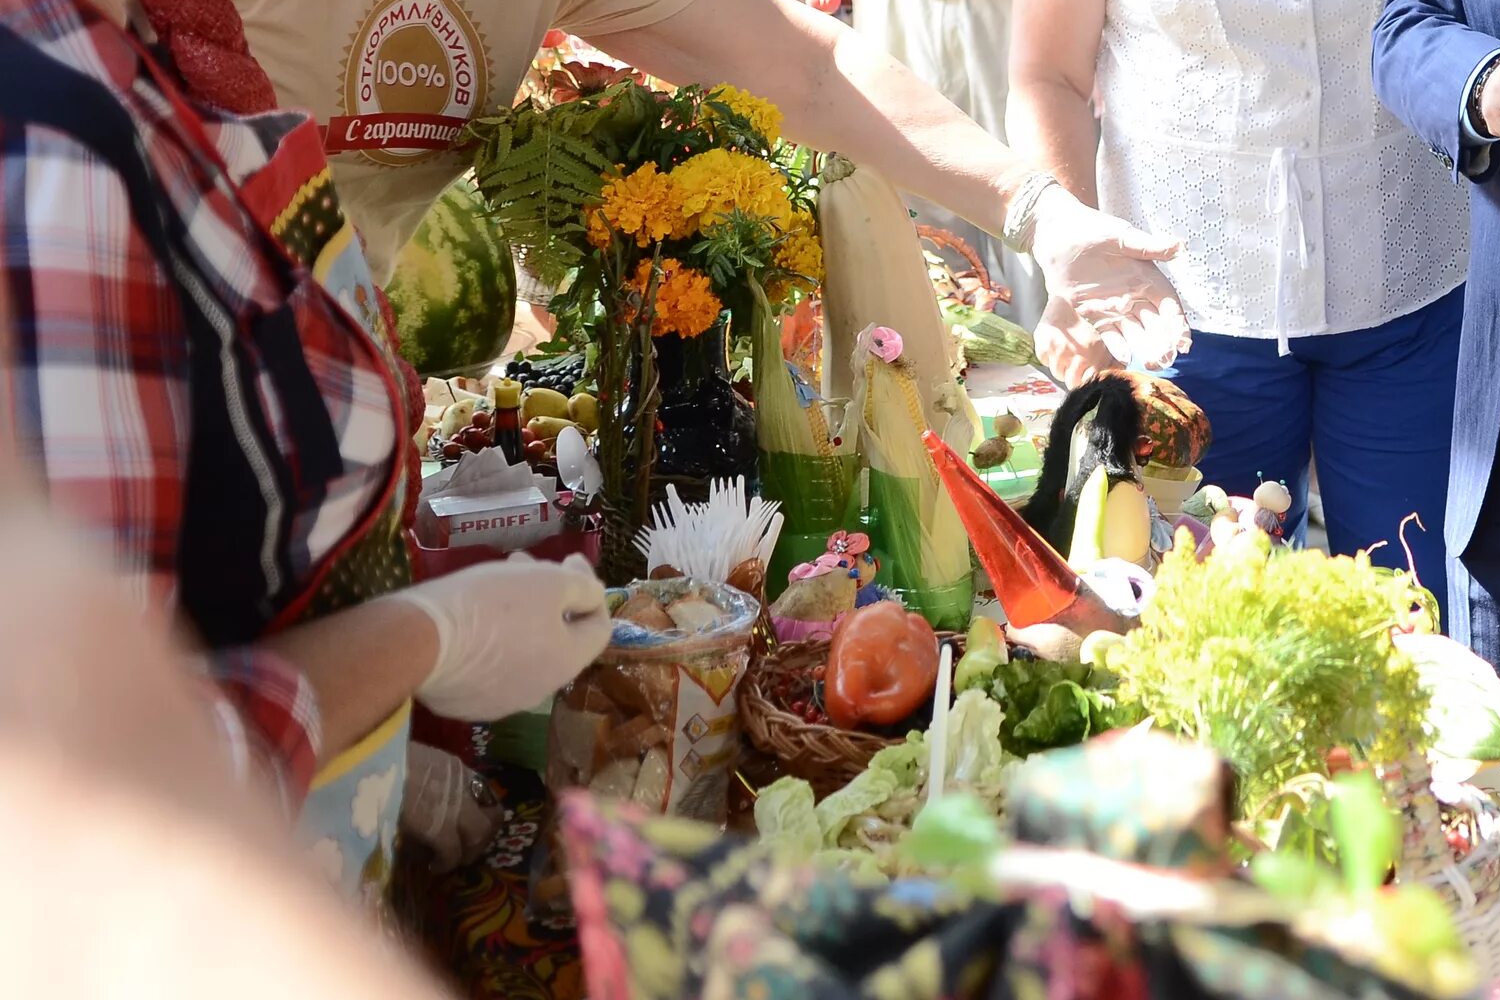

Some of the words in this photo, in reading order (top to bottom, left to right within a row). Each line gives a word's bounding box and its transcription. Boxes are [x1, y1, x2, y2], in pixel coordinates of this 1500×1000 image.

[431, 11, 472, 106] ВНУКОВ
[376, 59, 446, 88] 100%
[345, 119, 361, 142] С
